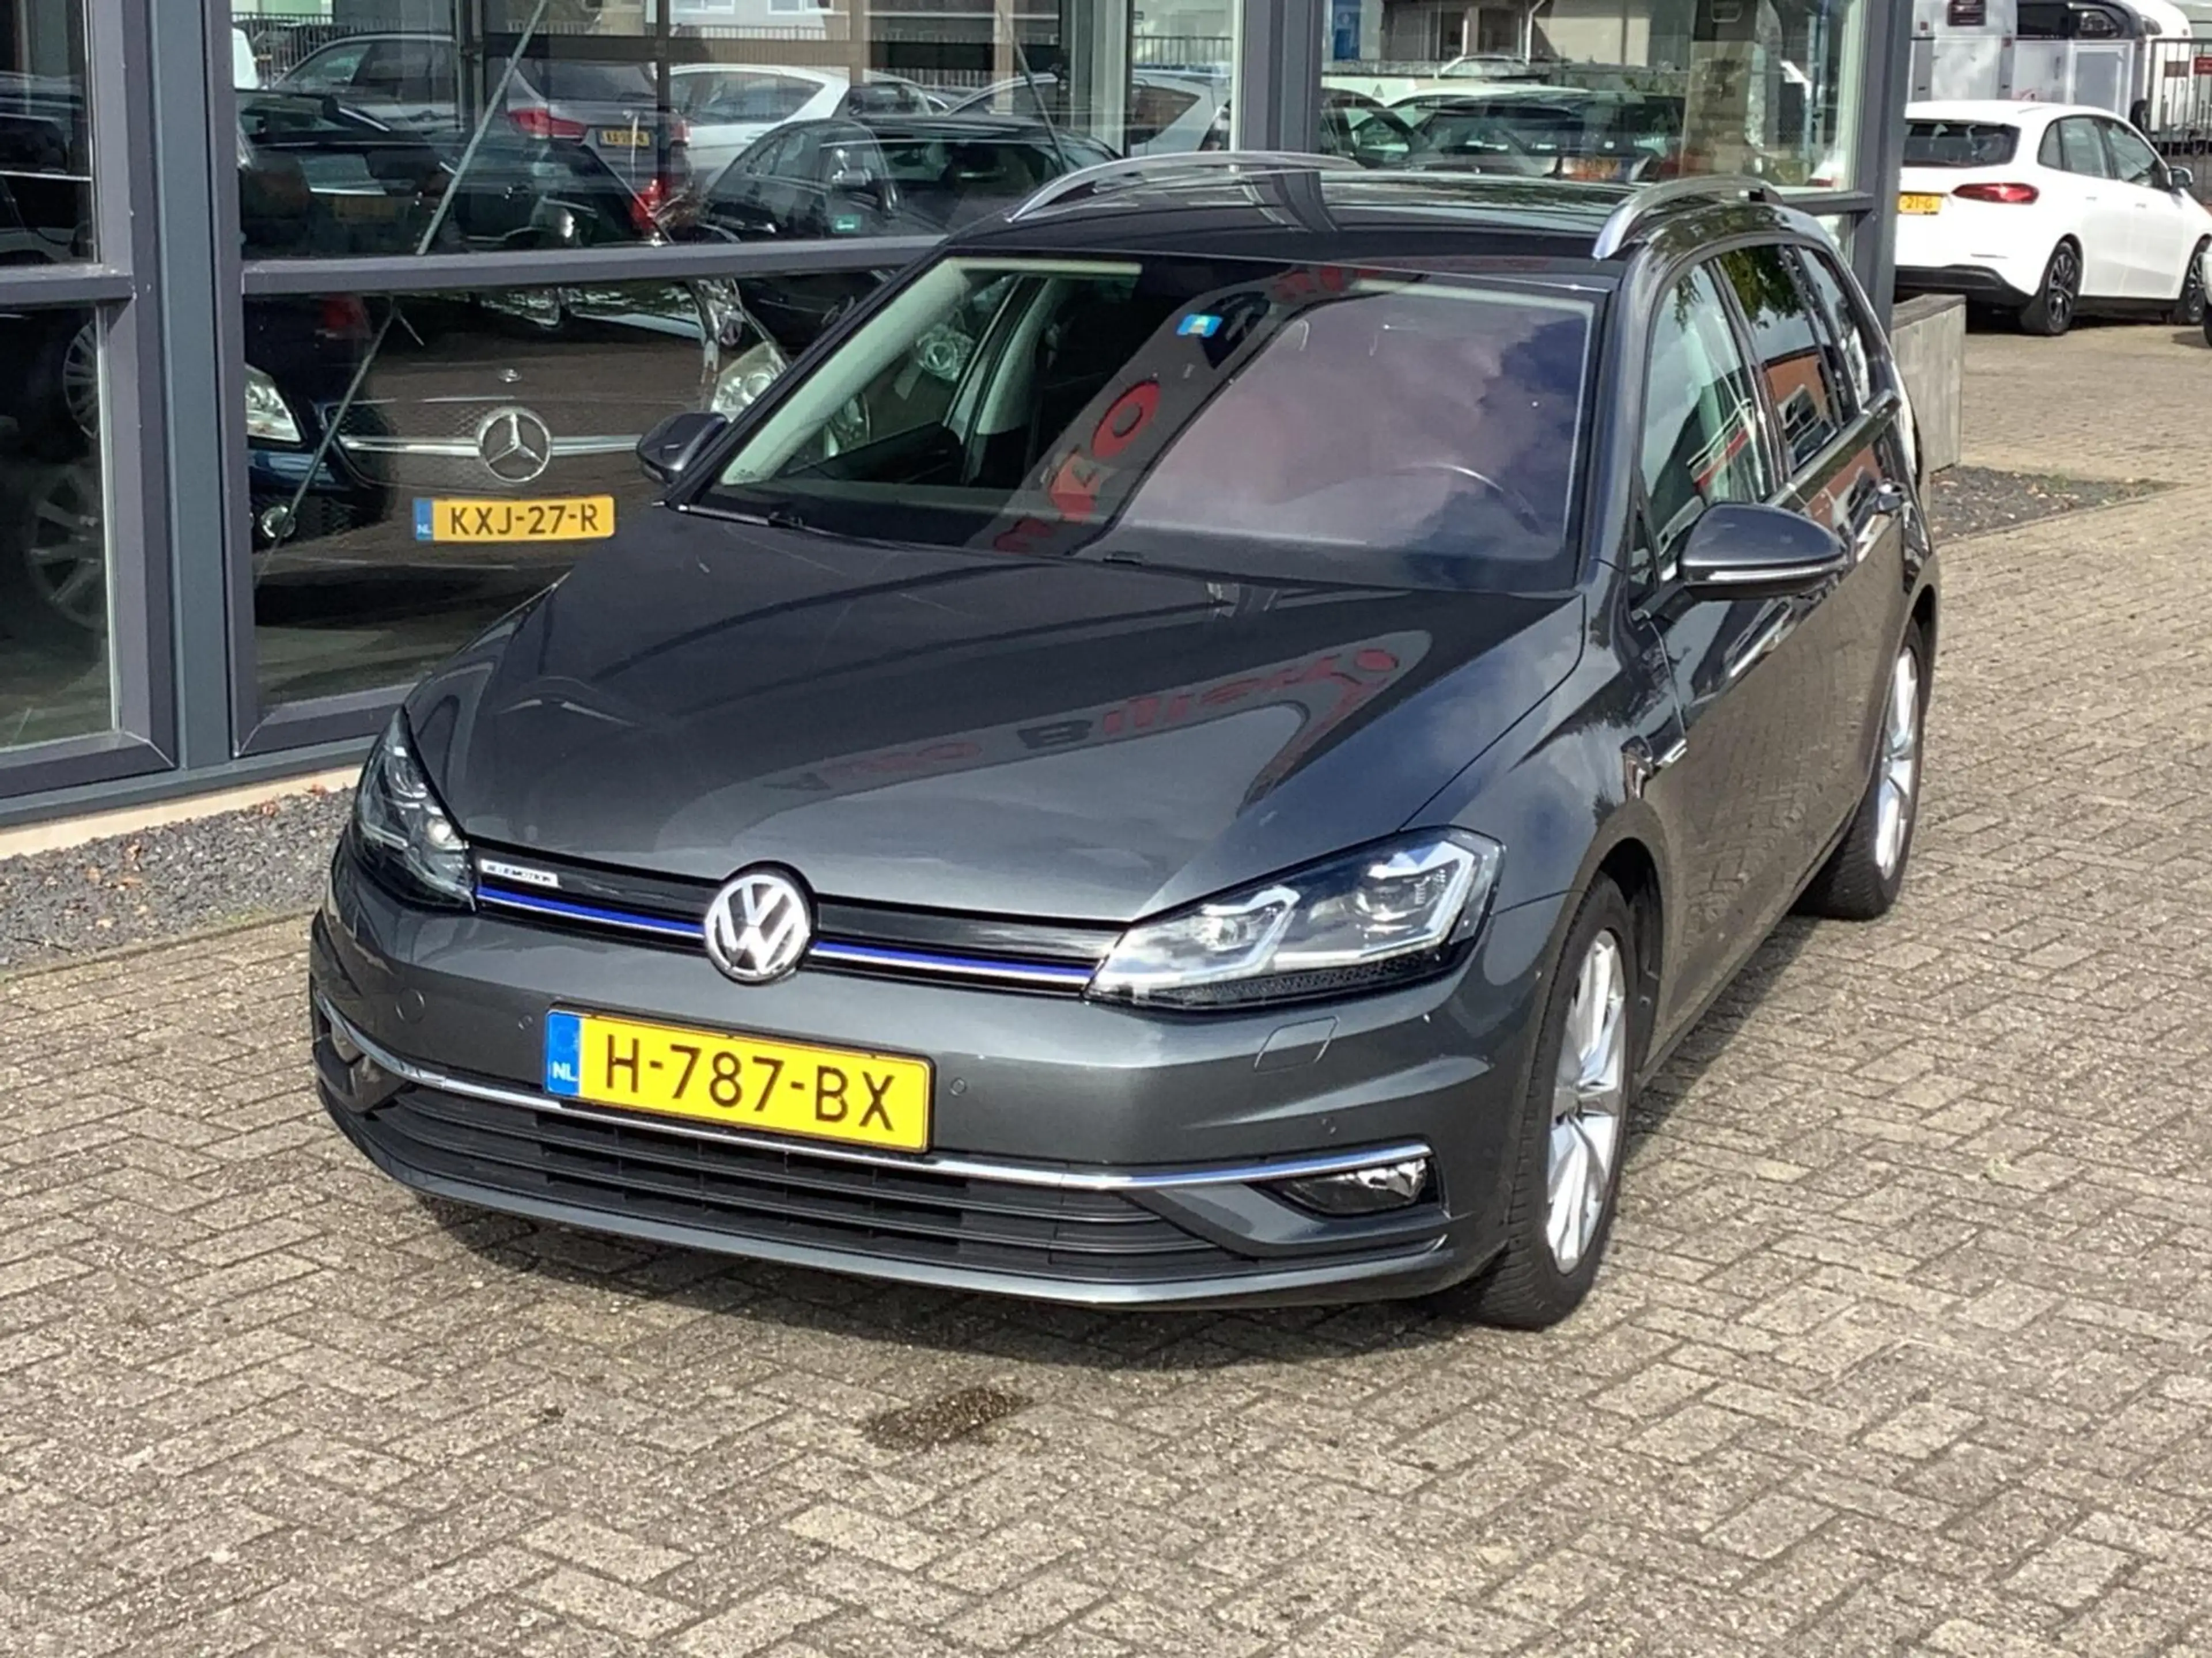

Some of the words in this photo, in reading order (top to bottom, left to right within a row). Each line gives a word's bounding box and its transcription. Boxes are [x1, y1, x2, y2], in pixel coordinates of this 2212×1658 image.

[416, 523, 432, 534] NL
[450, 503, 599, 536] KXJ-27-R
[551, 1060, 578, 1082] NL
[606, 1034, 895, 1132] H-787-BX
